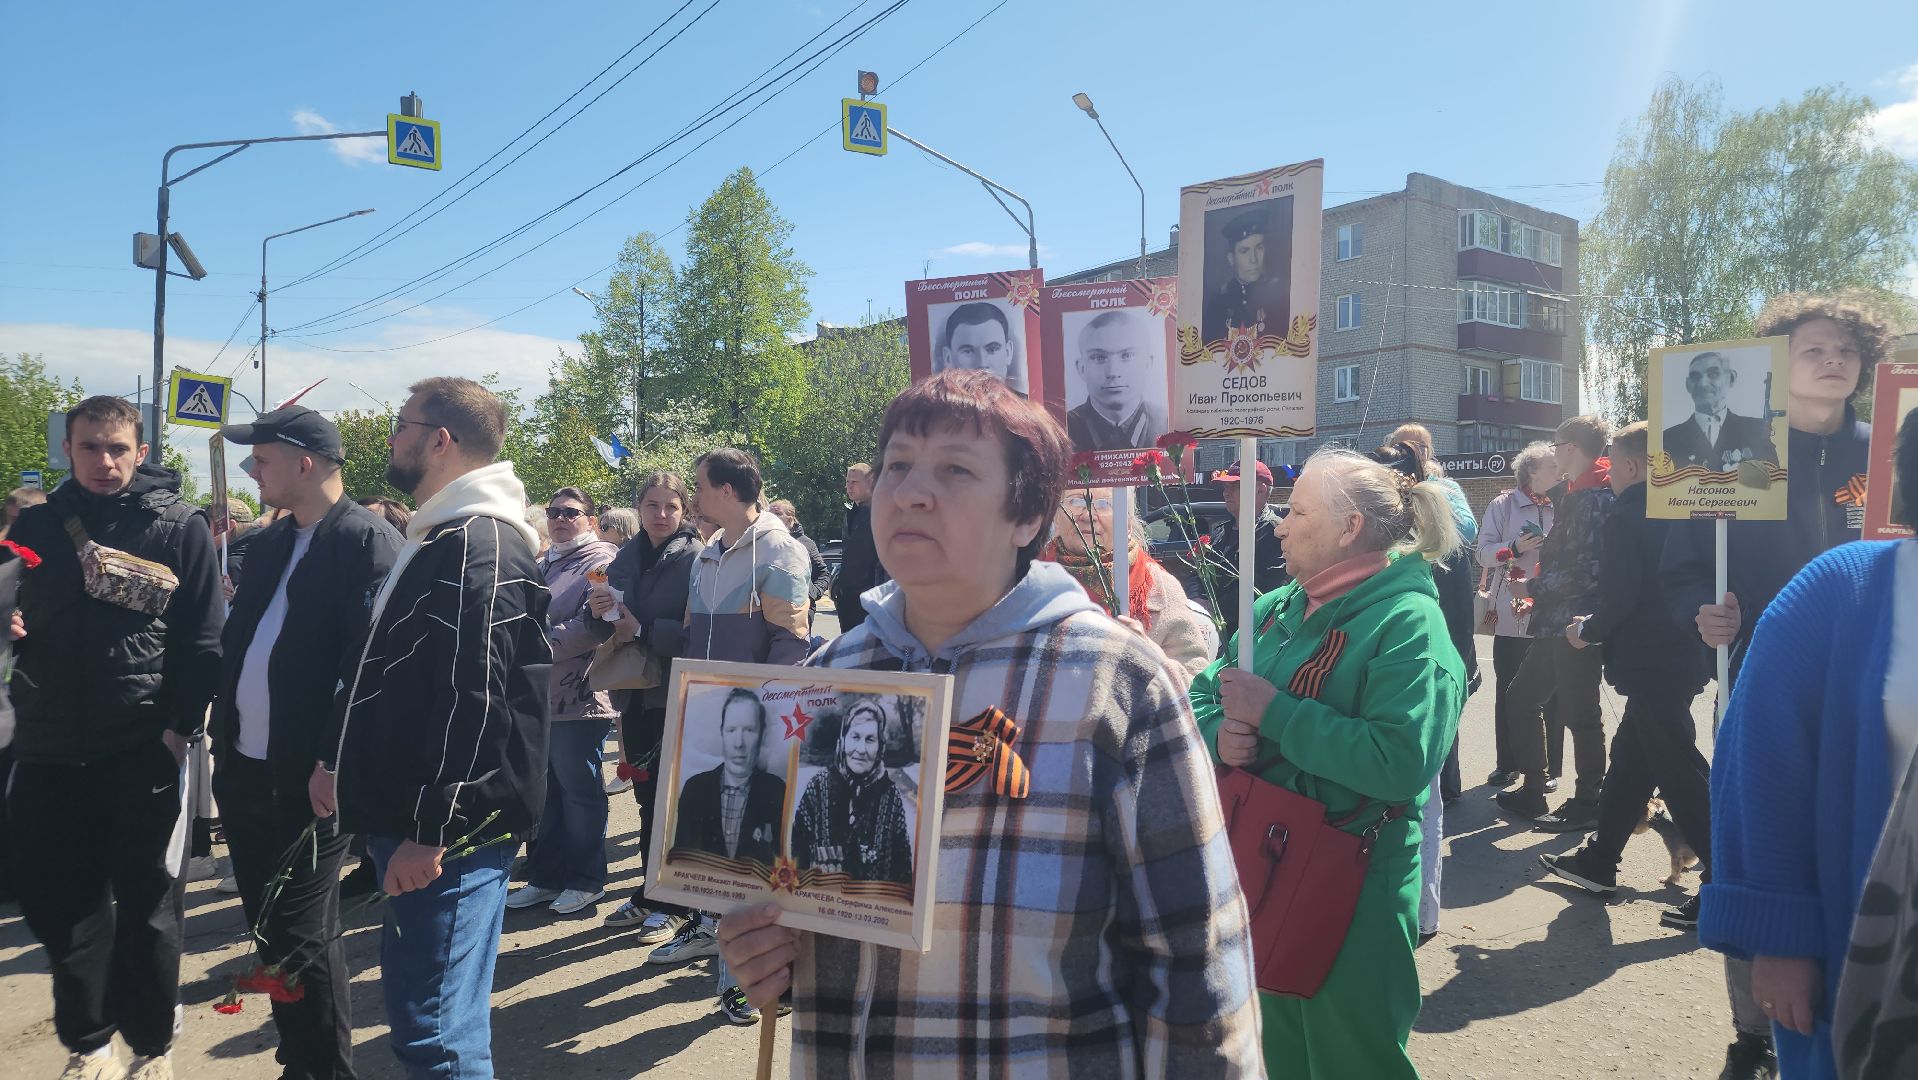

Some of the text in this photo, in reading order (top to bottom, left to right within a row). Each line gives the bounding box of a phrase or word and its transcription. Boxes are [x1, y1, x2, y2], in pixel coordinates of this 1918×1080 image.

[917, 277, 989, 292] Бессмертный
[954, 289, 988, 301] ПОЛК
[1051, 284, 1127, 299] Бессмертный
[1090, 297, 1127, 309] ПОЛК
[1222, 375, 1267, 391] СЕДОВ
[1189, 392, 1302, 406] Иван Прокопьевич
[1100, 452, 1135, 461] МИХАИЛ
[1688, 485, 1736, 495] Насонов
[1668, 497, 1757, 508] Иван Сергеевич
[807, 697, 838, 708] ПОЛК
